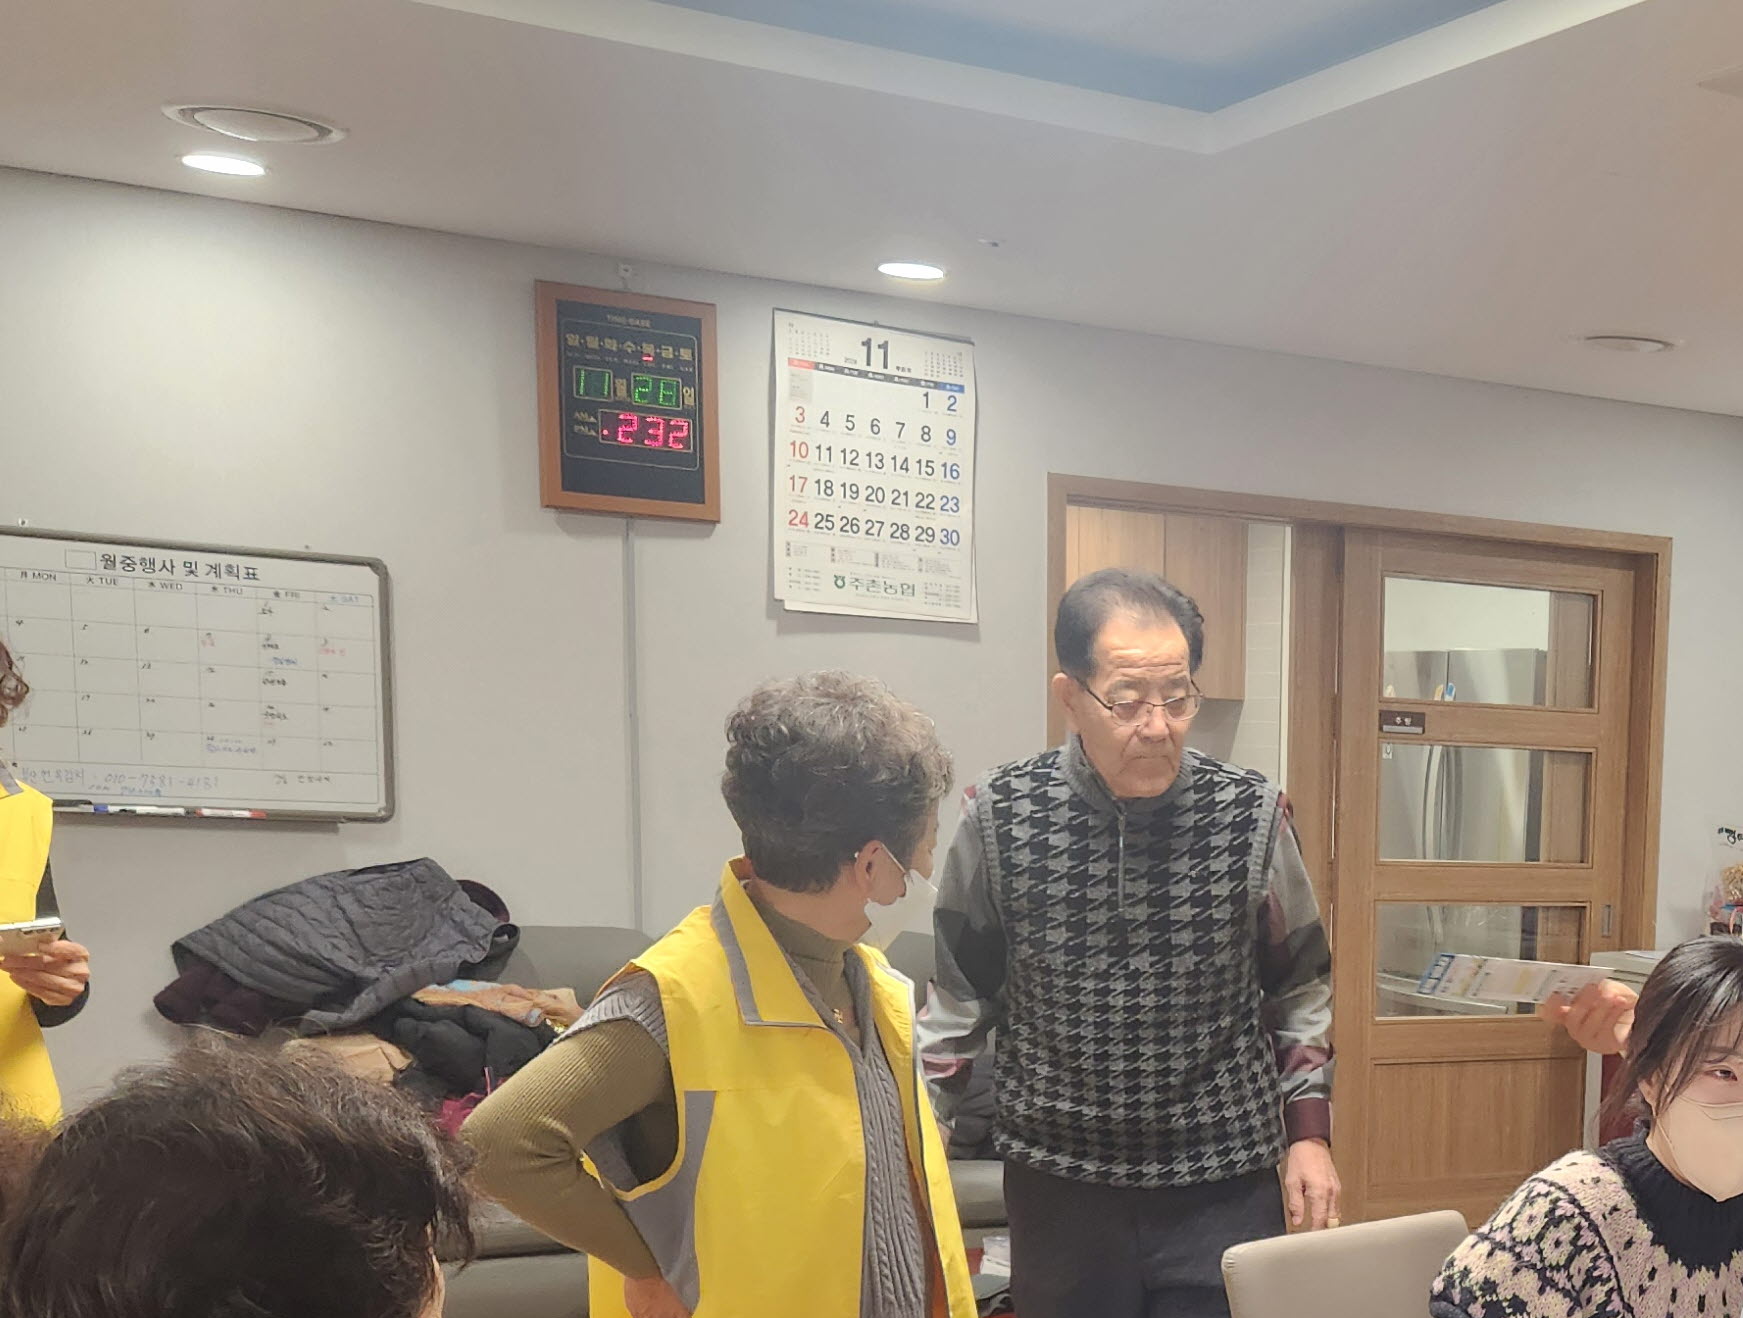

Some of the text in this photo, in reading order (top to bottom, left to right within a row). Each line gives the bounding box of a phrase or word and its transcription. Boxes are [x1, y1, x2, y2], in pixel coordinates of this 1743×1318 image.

[861, 338, 889, 369] 11
[923, 392, 957, 412] 1 2
[795, 407, 956, 445] 3 4 5 6 7 8 9
[790, 441, 960, 480] 10 11 12 13 14 15 16
[789, 475, 960, 513] 17 18 19 20 21 22 23
[788, 510, 960, 545] 24 25 26 27 28 29 30
[32, 572, 57, 582] MON
[99, 553, 260, 582] 월중행사 및 계획표
[160, 582, 182, 591] WED
[850, 576, 915, 597] 주촌농협
